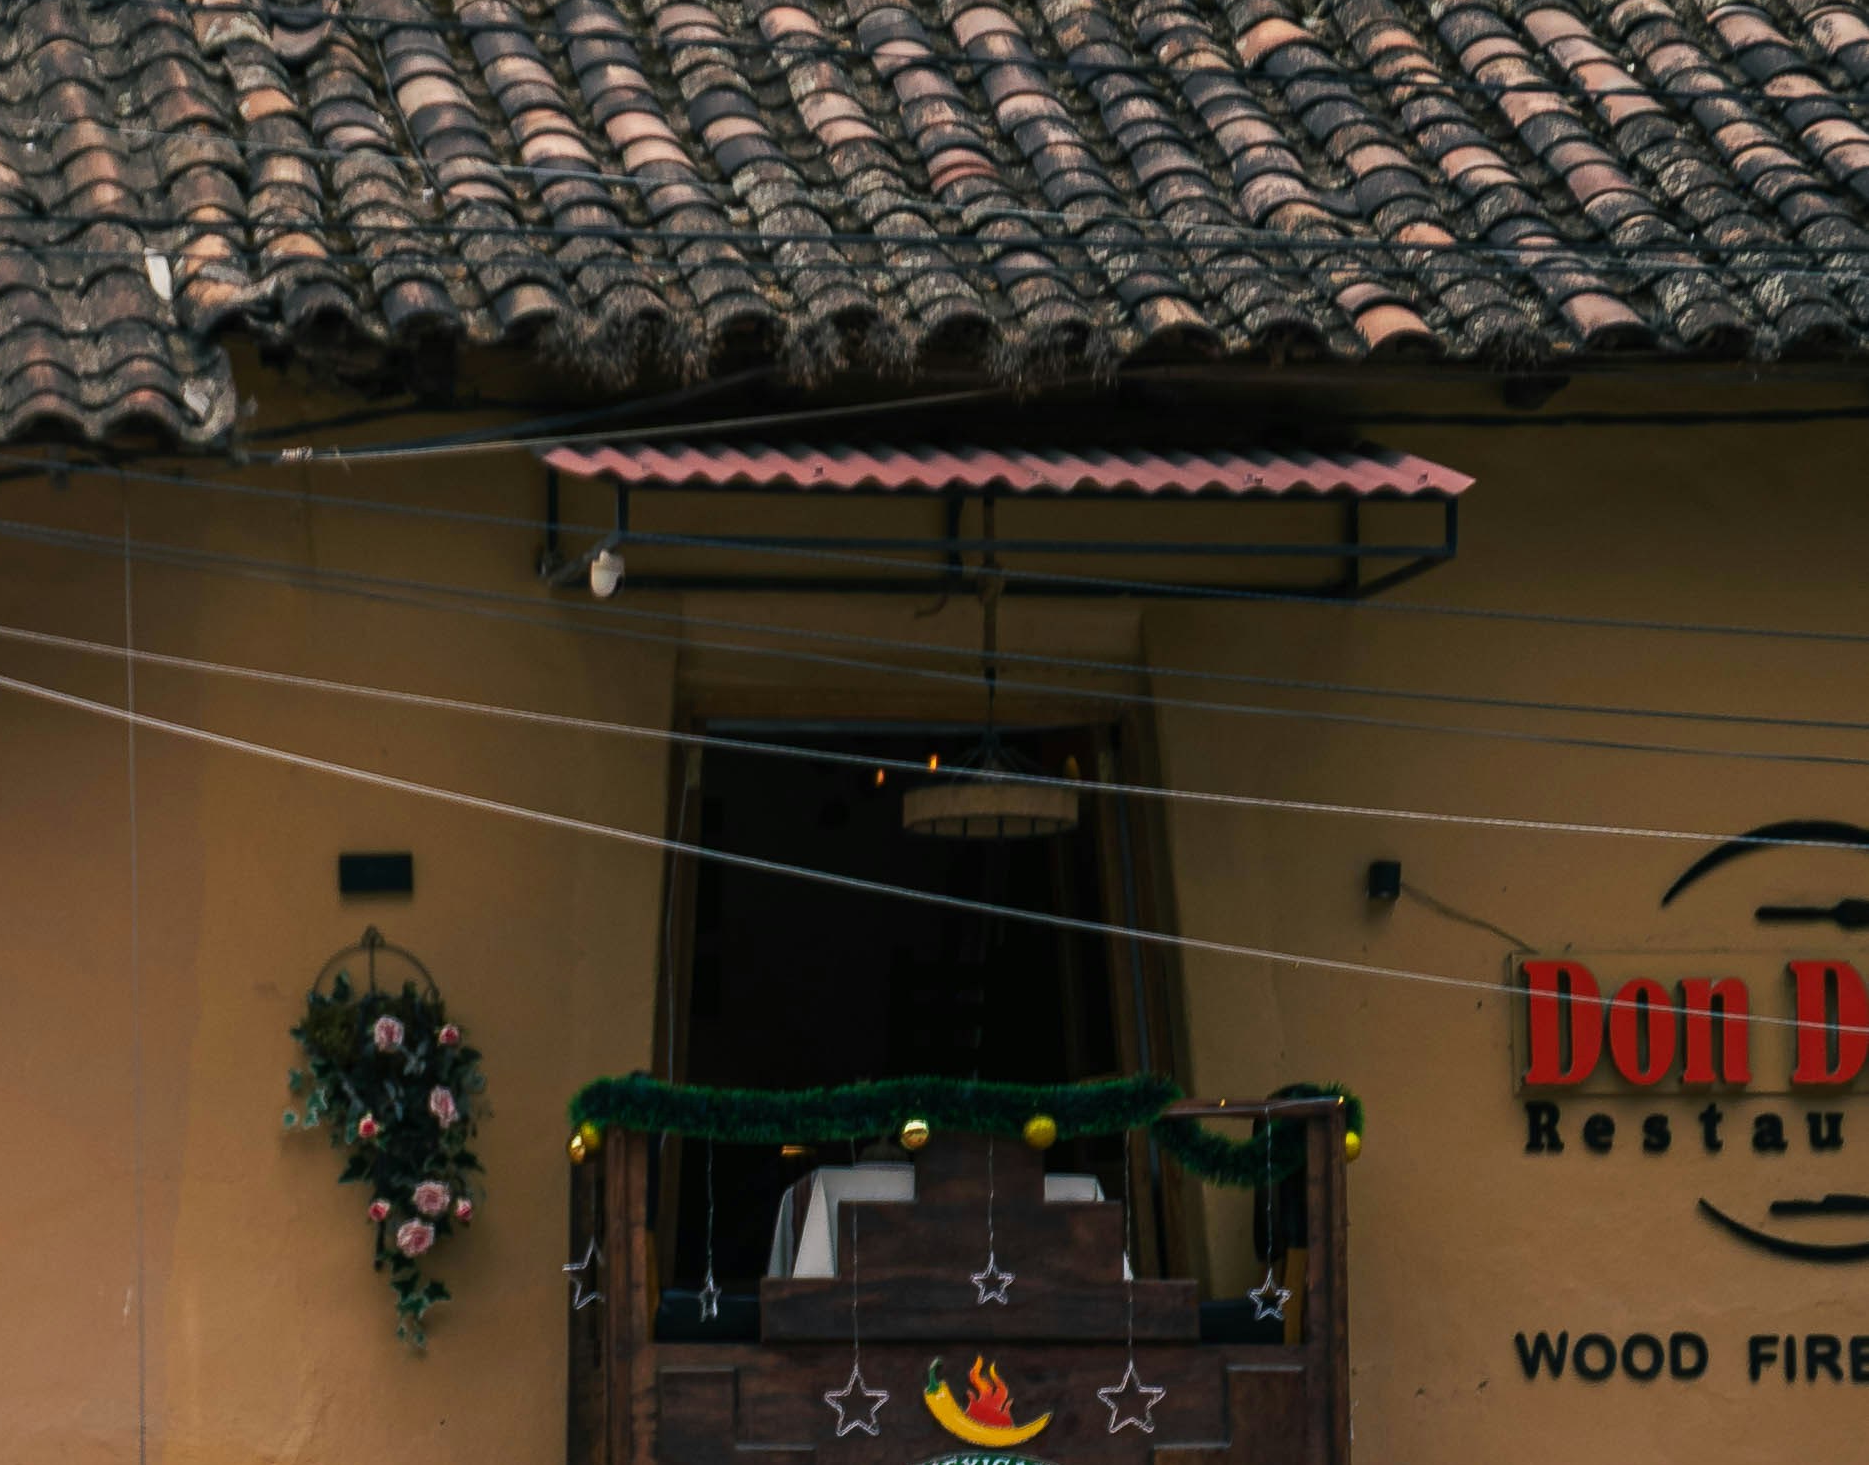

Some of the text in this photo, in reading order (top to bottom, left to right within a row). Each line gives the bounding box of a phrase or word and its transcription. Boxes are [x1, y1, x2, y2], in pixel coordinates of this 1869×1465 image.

[1522, 960, 1752, 1086] Don
[1524, 1101, 1844, 1154] Restau
[1514, 1330, 1710, 1382] WOOD
